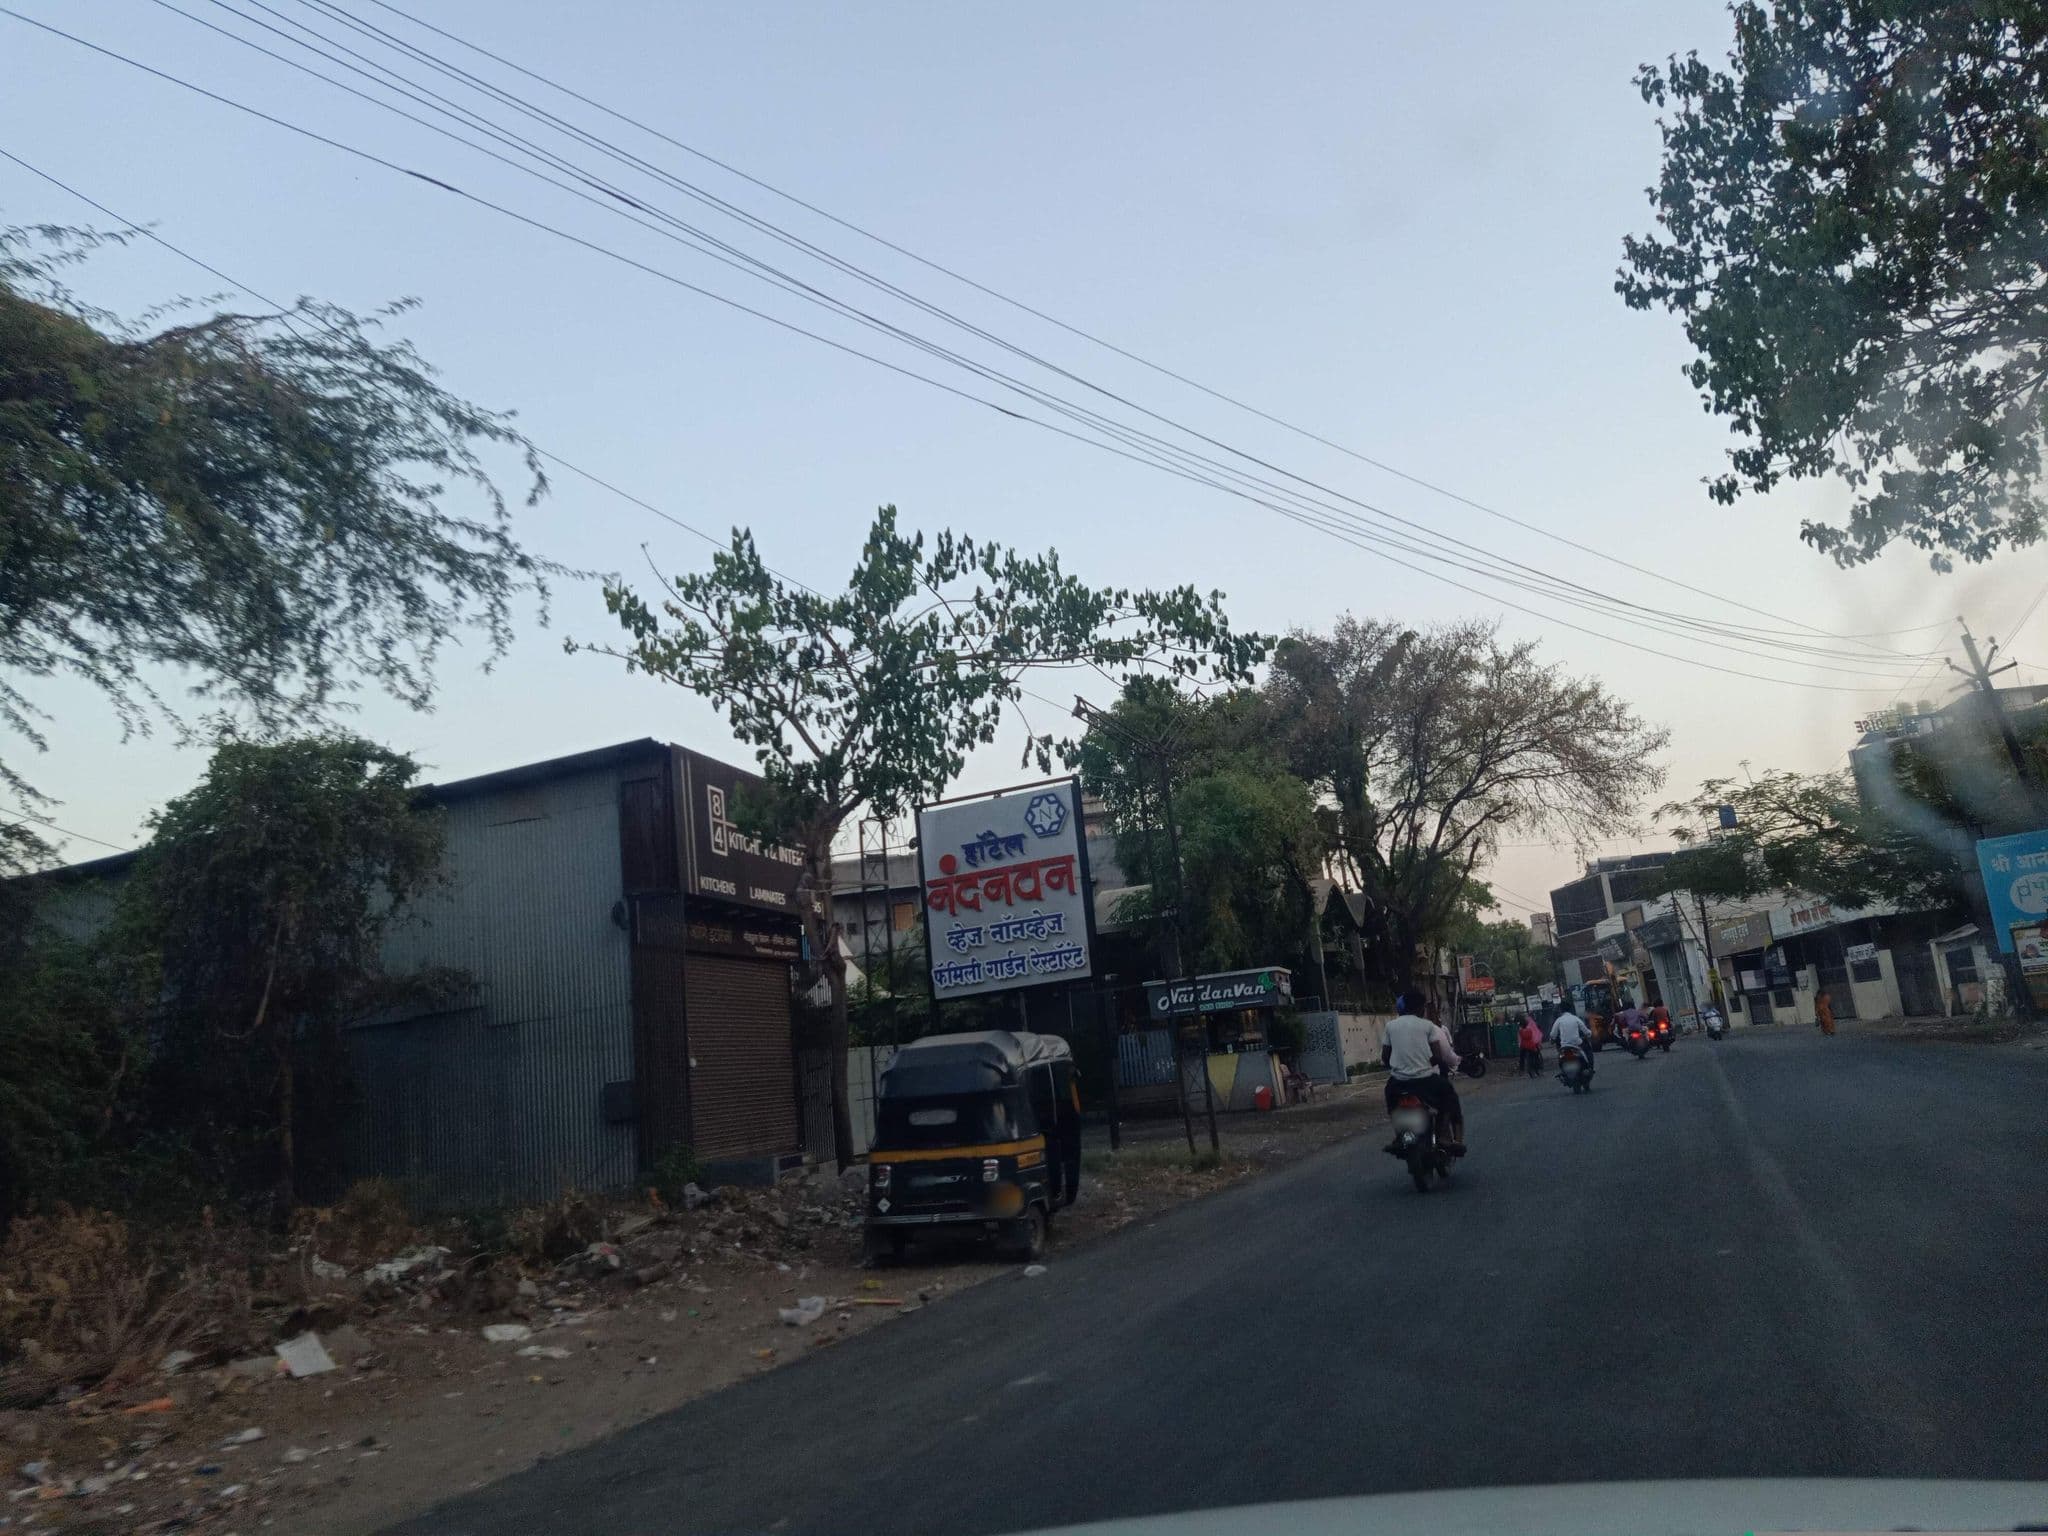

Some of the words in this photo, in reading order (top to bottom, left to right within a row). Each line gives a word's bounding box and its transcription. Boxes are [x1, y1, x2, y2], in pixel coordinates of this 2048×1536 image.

[712, 794, 721, 816] 8
[715, 826, 723, 848] 4
[700, 876, 736, 895] KITCHENS
[749, 886, 786, 905] LAMINATES
[926, 854, 1077, 917] नंदनवन
[946, 921, 983, 953] व्हेज
[989, 909, 1064, 942] नॉनव्हेज
[932, 957, 982, 987] फॅमिली
[985, 949, 1027, 978] गार्डन
